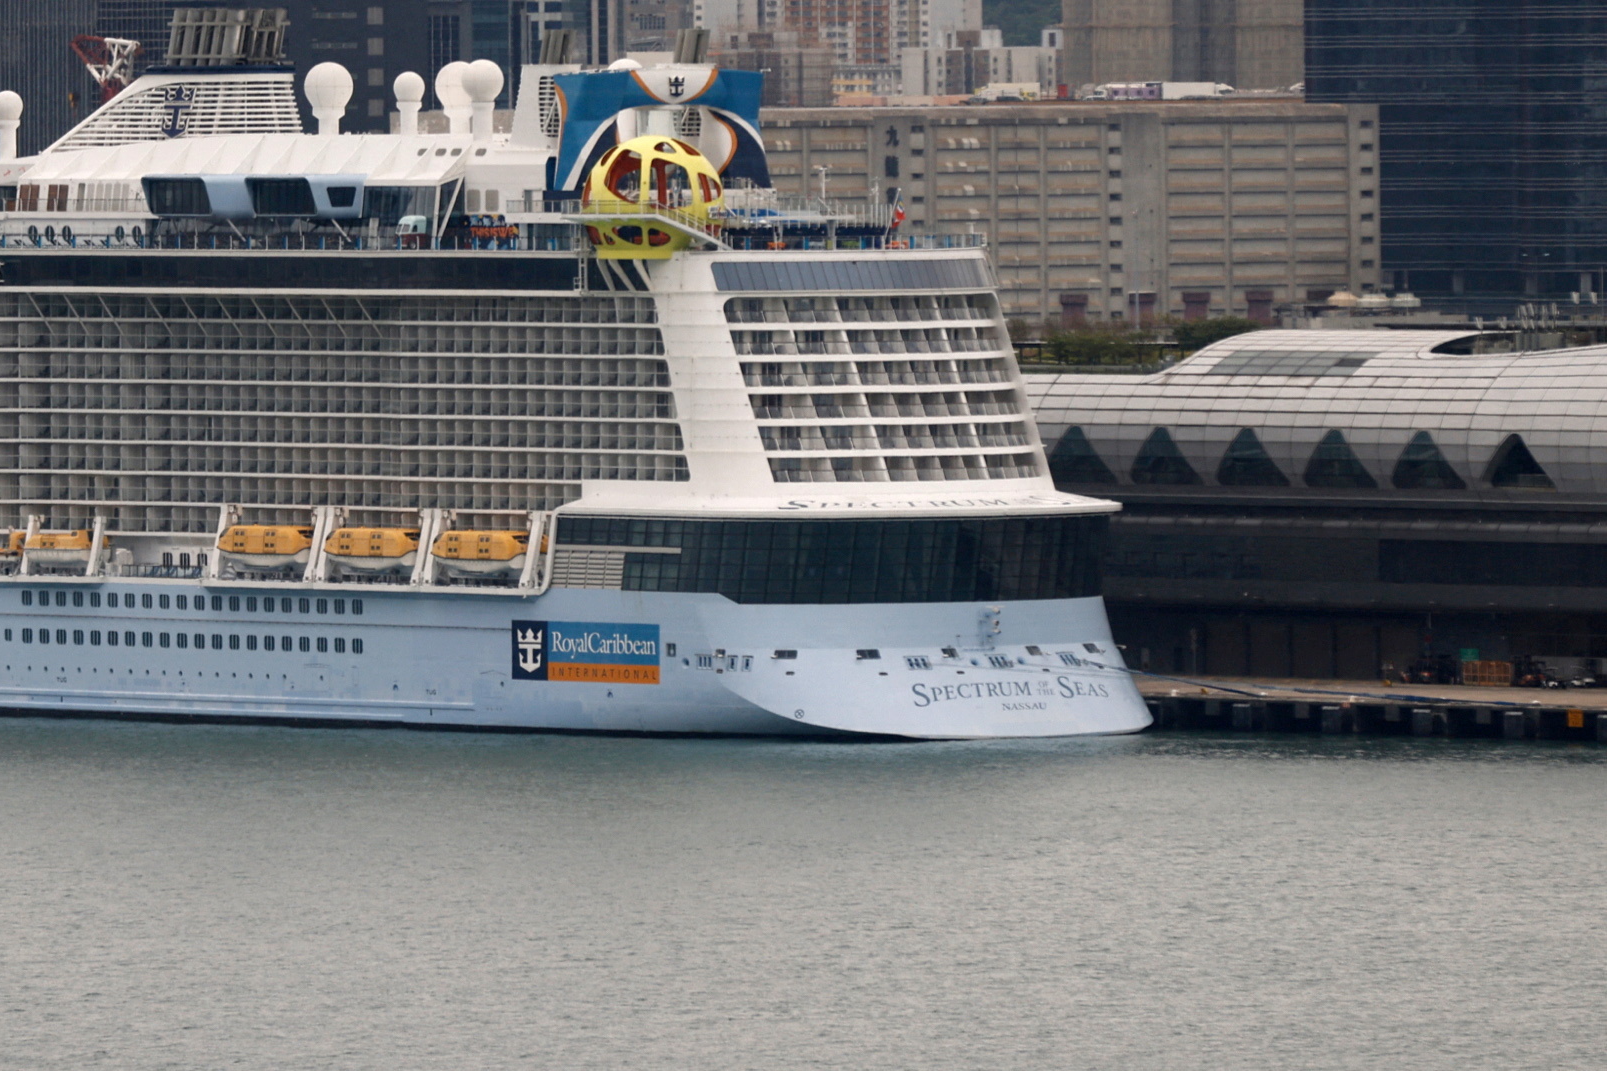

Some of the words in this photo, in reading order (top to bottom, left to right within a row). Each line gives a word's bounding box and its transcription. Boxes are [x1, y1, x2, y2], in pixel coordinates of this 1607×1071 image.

[552, 666, 656, 680] INTERNATIONAL
[911, 681, 1032, 708] SPECTRUM
[1057, 675, 1109, 699] SEAS
[1002, 702, 1047, 711] NASSAU
